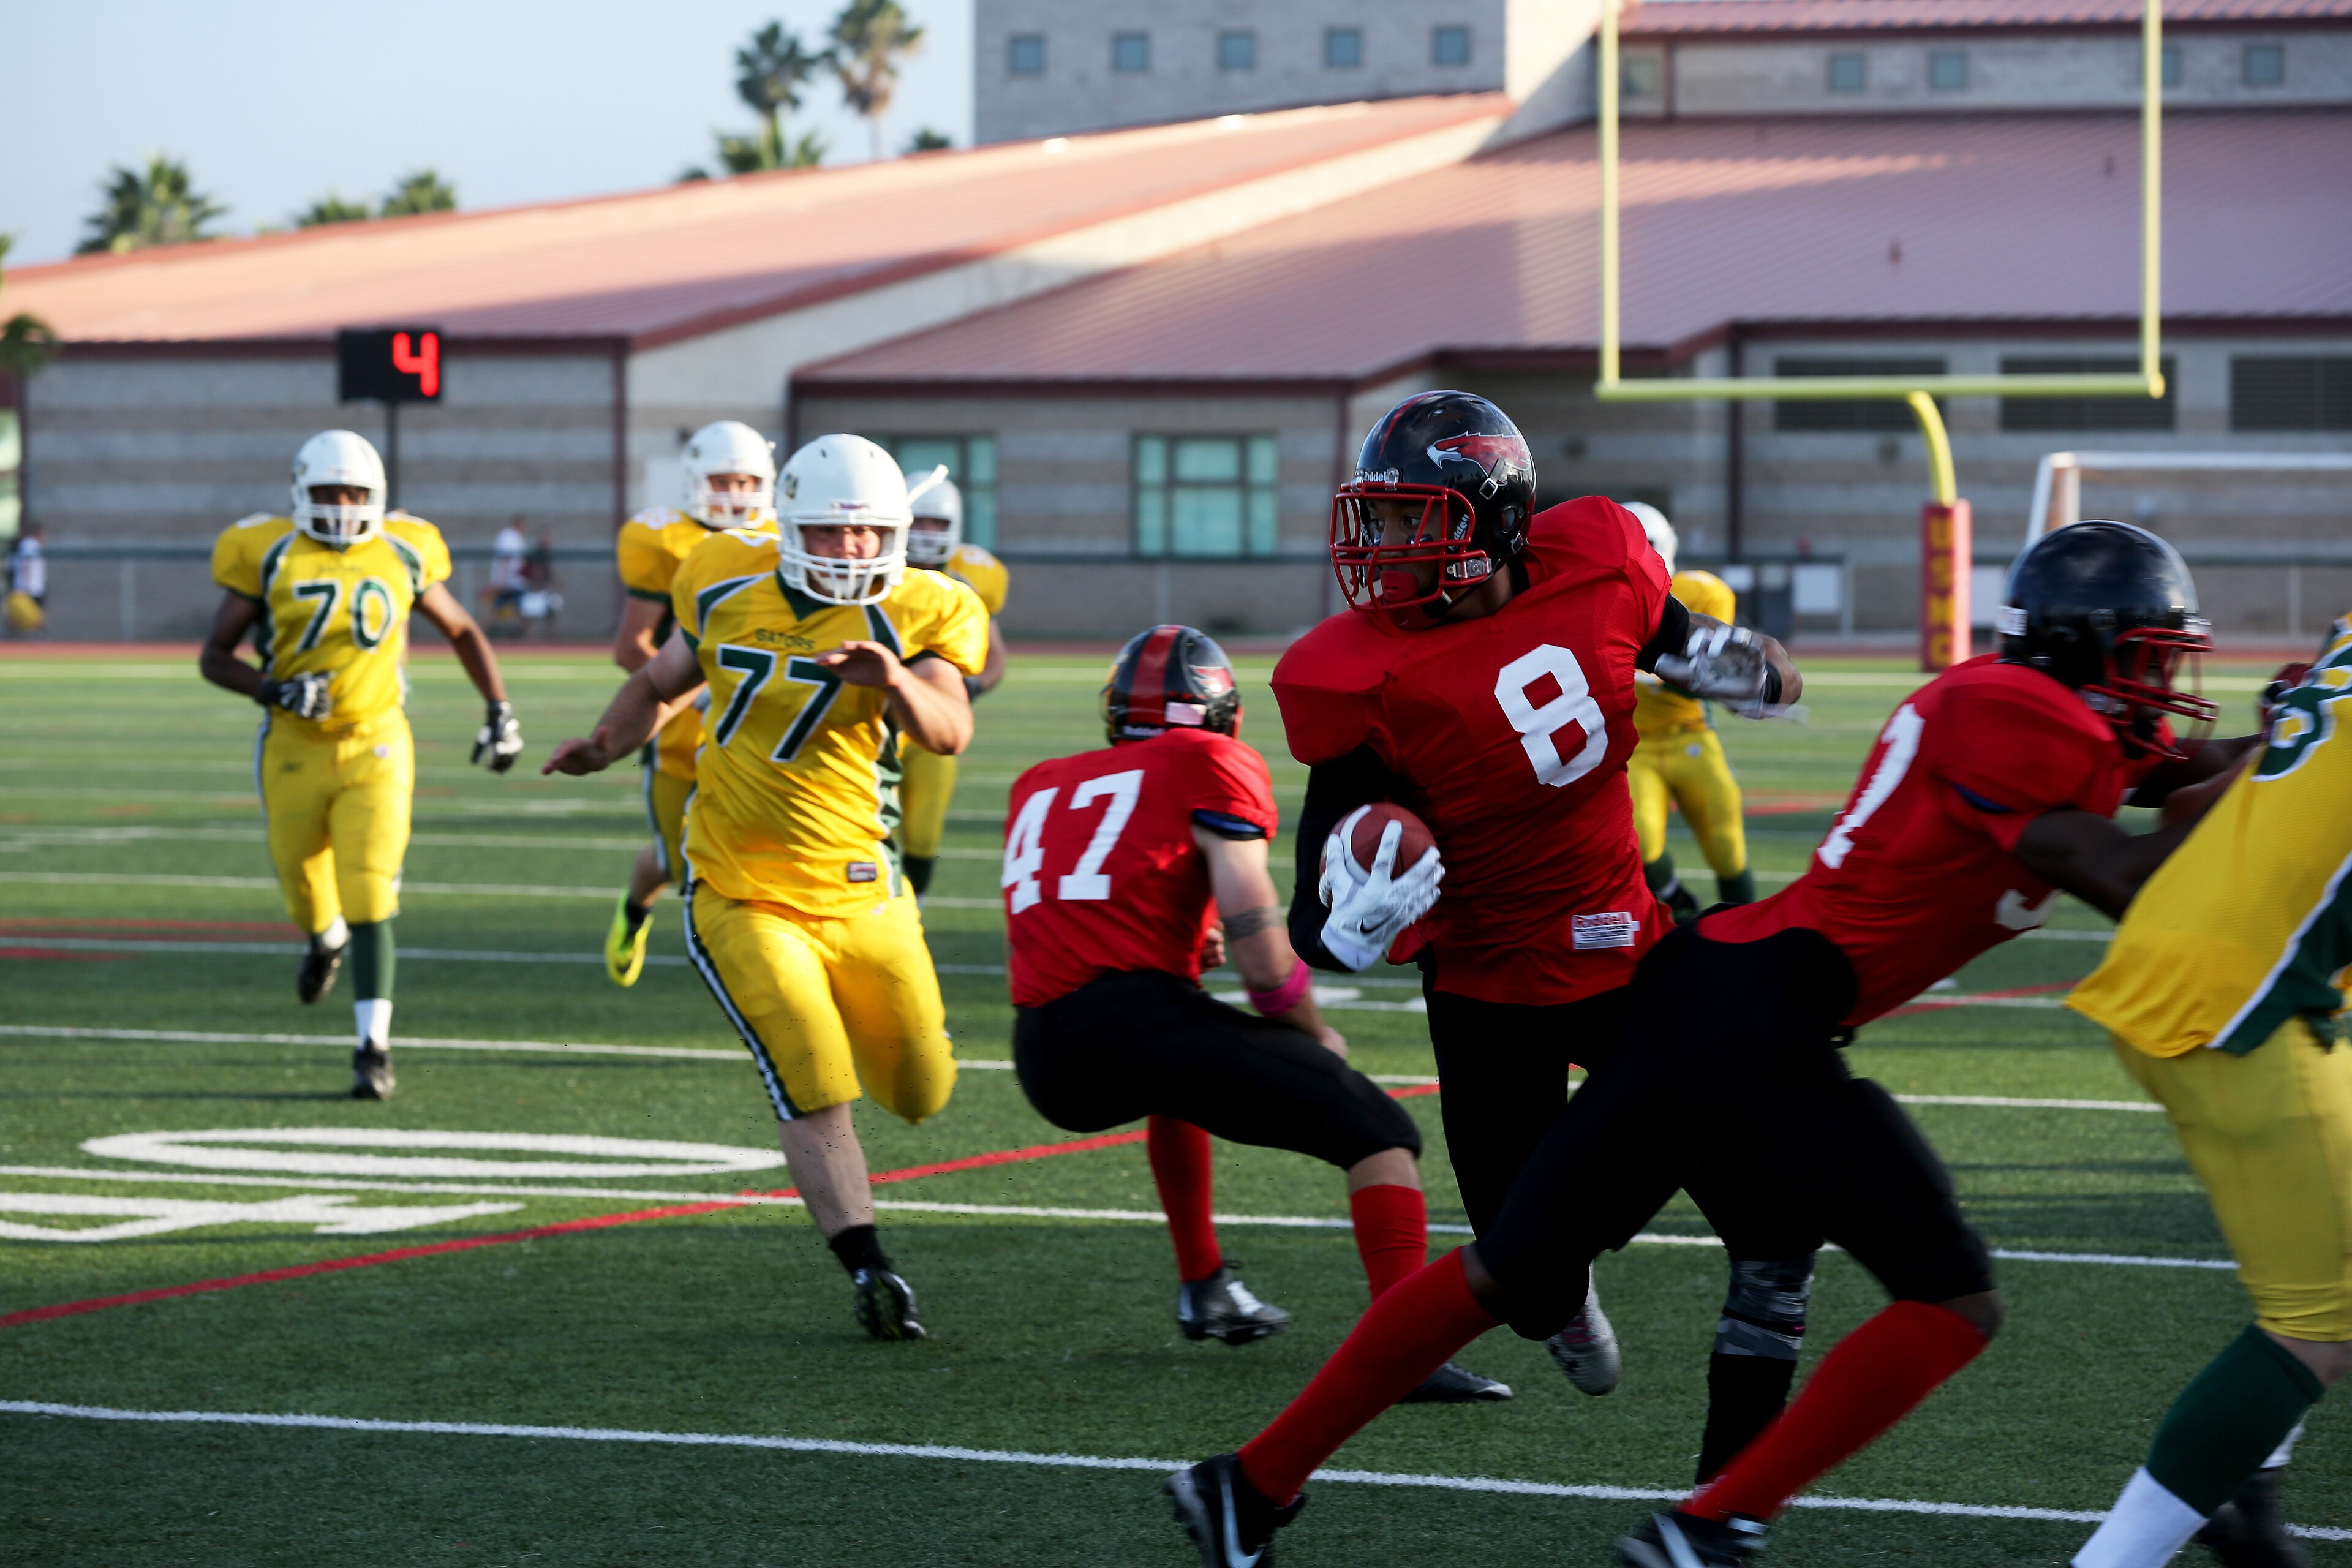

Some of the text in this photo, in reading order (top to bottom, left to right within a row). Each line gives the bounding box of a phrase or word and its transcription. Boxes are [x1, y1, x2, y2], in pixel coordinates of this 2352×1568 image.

[392, 331, 439, 398] 4
[1448, 513, 1469, 551] Rddell
[292, 576, 396, 654] 70
[755, 628, 815, 651] GATORS
[715, 643, 845, 762] 77
[1494, 643, 1609, 788] 8
[1001, 769, 1145, 914] 47
